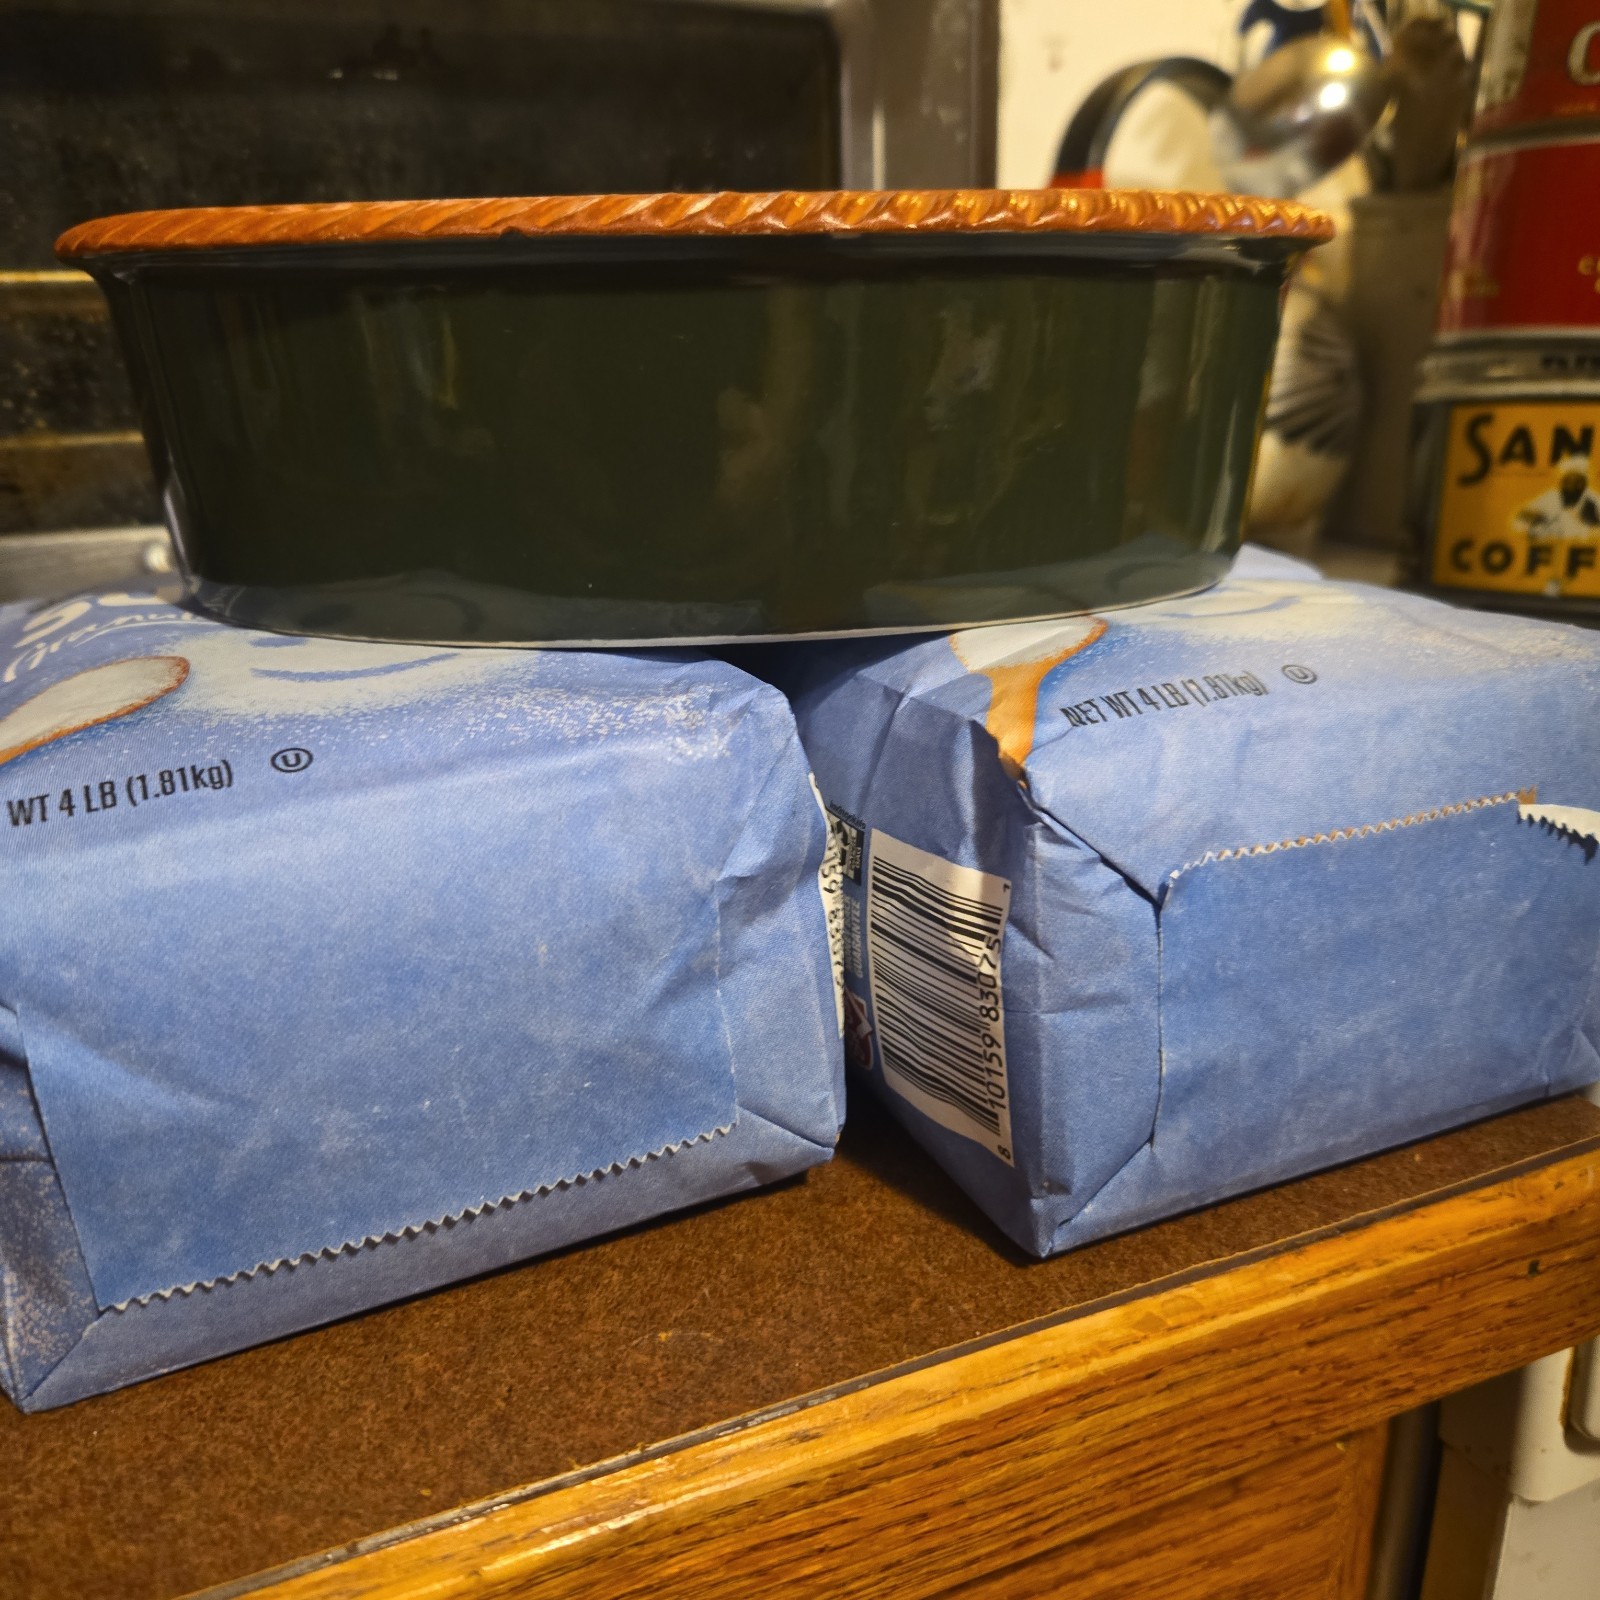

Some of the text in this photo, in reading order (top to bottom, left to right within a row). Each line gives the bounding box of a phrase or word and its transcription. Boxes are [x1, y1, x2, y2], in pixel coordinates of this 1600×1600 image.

[1451, 539, 1597, 579] COFF
[1059, 699, 1107, 727] NET
[1100, 690, 1143, 719] WT
[1138, 687, 1160, 711] 4
[1151, 682, 1186, 709] LB
[1180, 670, 1270, 707] (1.81kg)
[8, 794, 51, 827] WT
[60, 789, 75, 817] 4
[84, 781, 117, 813] LB
[126, 760, 233, 807] (1.81kg)
[977, 935, 1002, 1023] 83075
[985, 1037, 1007, 1111] 10159
[997, 1145, 1012, 1161] 8
